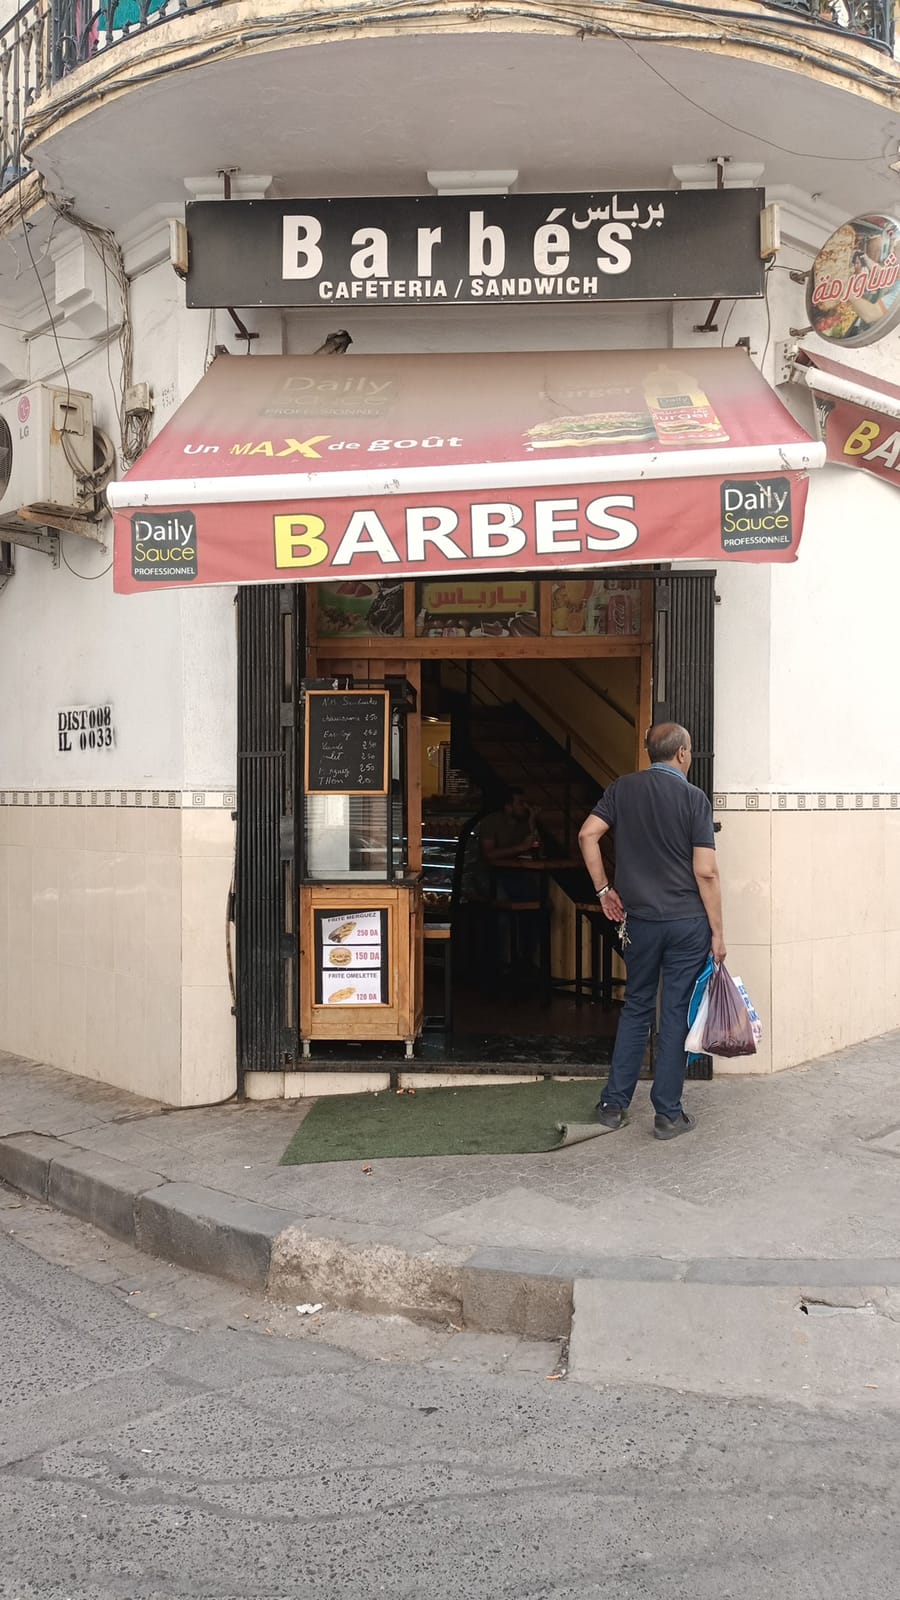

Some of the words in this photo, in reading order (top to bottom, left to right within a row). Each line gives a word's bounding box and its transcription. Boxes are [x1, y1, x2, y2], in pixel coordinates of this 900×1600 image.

[572, 195, 665, 230] برباس
[282, 208, 632, 280] Barbés
[318, 279, 448, 300] CAFETERIA
[470, 276, 599, 297] SANDWICH
[811, 253, 900, 304] شاورمة
[20, 426, 30, 440] LG
[843, 419, 900, 469] BA
[183, 444, 219, 455] Un
[229, 435, 333, 458] MAX
[328, 440, 361, 451] de
[367, 436, 464, 452] goût
[725, 484, 788, 515] Daily
[135, 519, 194, 546] Daily
[272, 494, 640, 570] BARBES
[723, 512, 789, 533] Sauce
[723, 535, 790, 547] PROFESSIONNEL
[134, 543, 195, 562] Sauce
[134, 566, 196, 576] PROFESSIONNEL
[80, 727, 112, 751] 0033
[360, 763, 375, 772] 250
[346, 912, 377, 920] MERGUEZ
[357, 929, 368, 937] 250
[370, 929, 379, 937] DA
[355, 952, 368, 961] 150
[370, 952, 380, 961] DA
[356, 993, 367, 1001] 120
[369, 993, 378, 1001] DA
